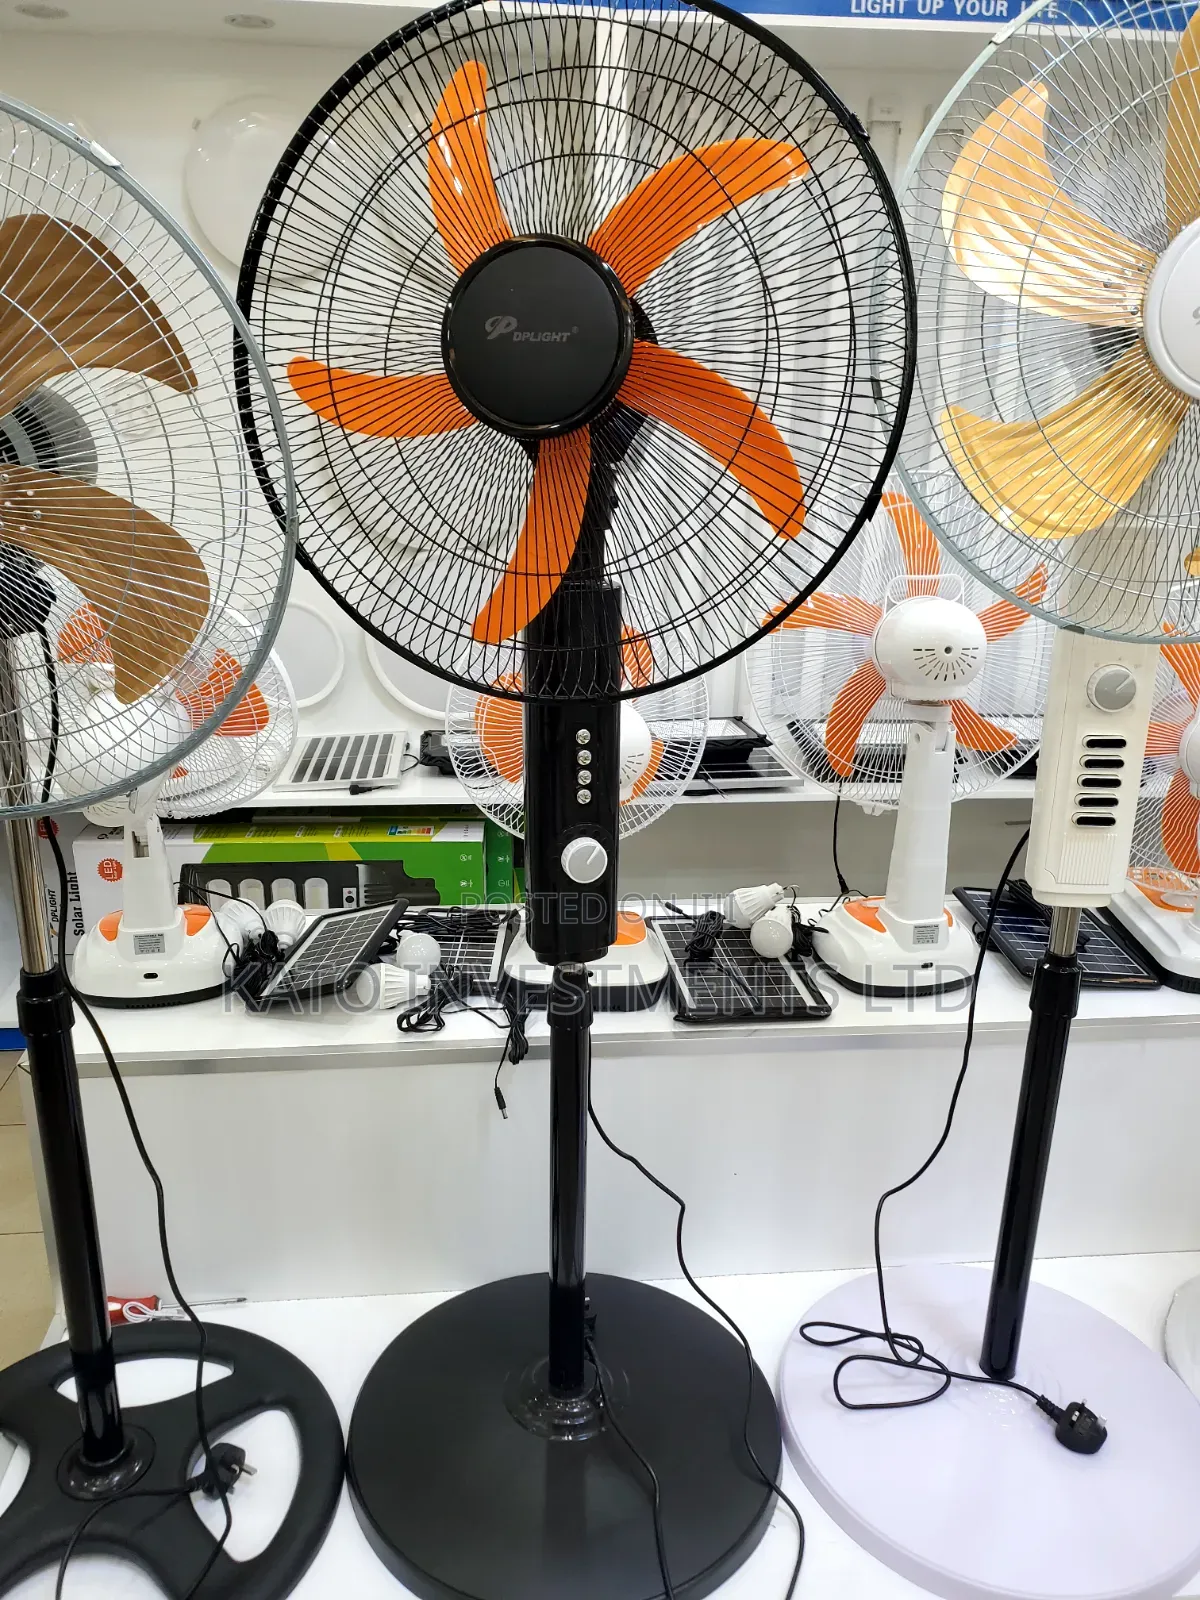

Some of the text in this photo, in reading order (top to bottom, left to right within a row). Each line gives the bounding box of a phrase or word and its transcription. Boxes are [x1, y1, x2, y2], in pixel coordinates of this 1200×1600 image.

[850, 0, 908, 14] LIGHT
[917, 0, 944, 15] UP
[953, 0, 1008, 17] YOUR
[512, 331, 571, 342] DPLIGHT
[103, 860, 115, 880] LED
[47, 888, 59, 923] DPLIGHT
[66, 871, 86, 937] Solar Light
